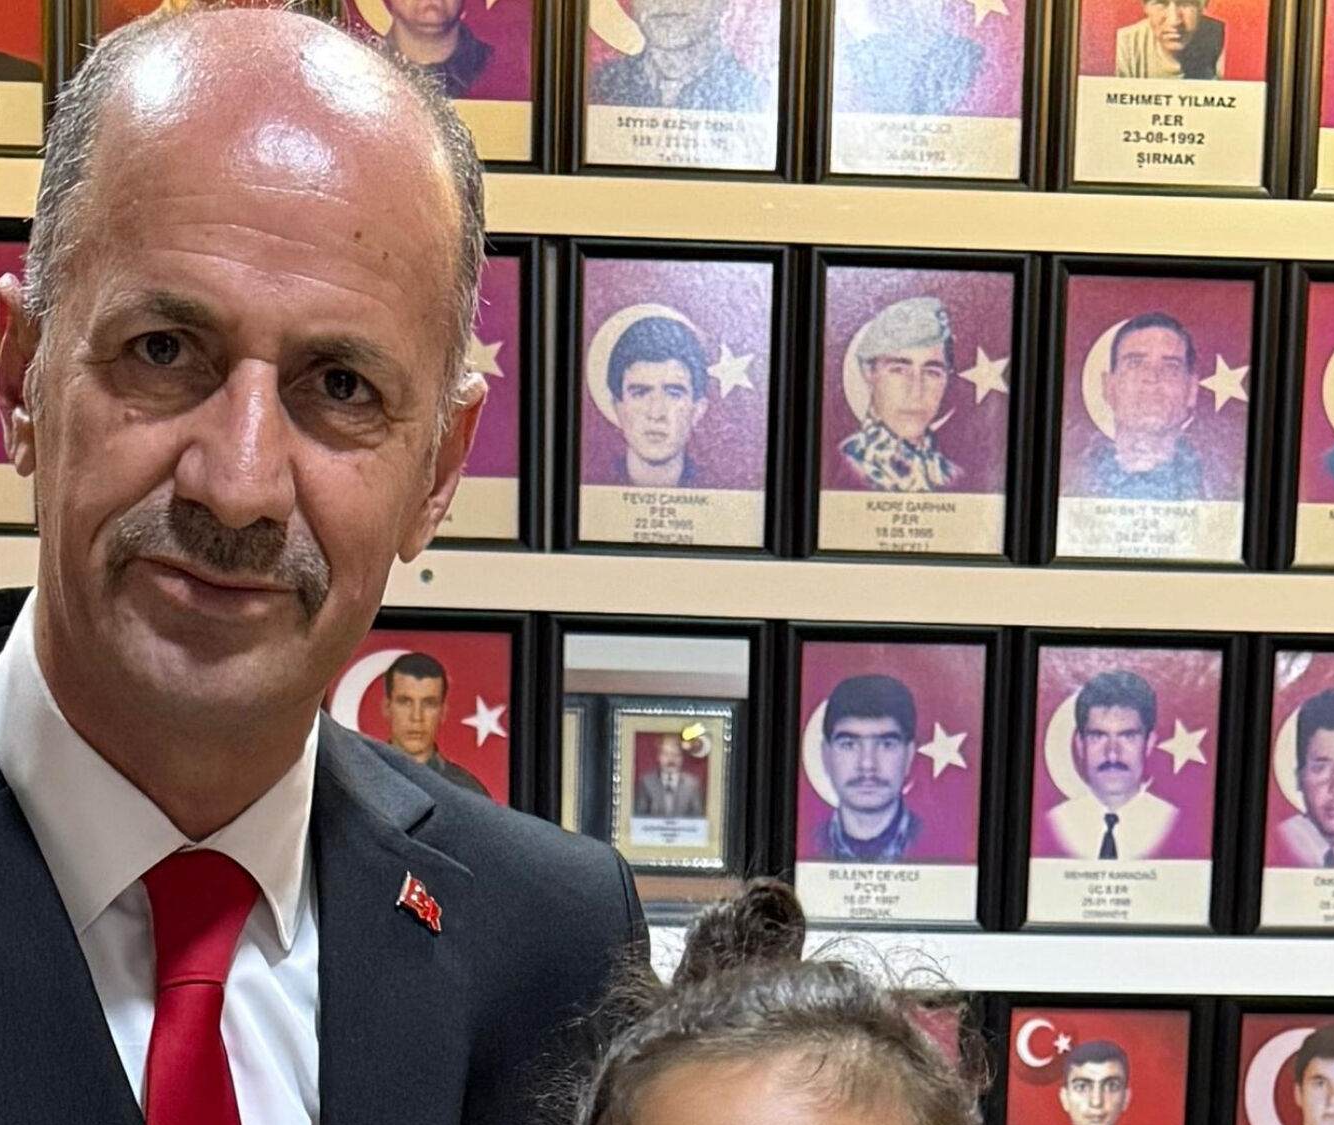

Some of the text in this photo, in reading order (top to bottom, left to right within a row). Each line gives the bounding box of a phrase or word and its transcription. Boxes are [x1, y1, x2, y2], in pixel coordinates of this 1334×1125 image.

[1106, 93, 1236, 108] MEHMET YILMAZ
[1123, 130, 1205, 145] 23-08-1992
